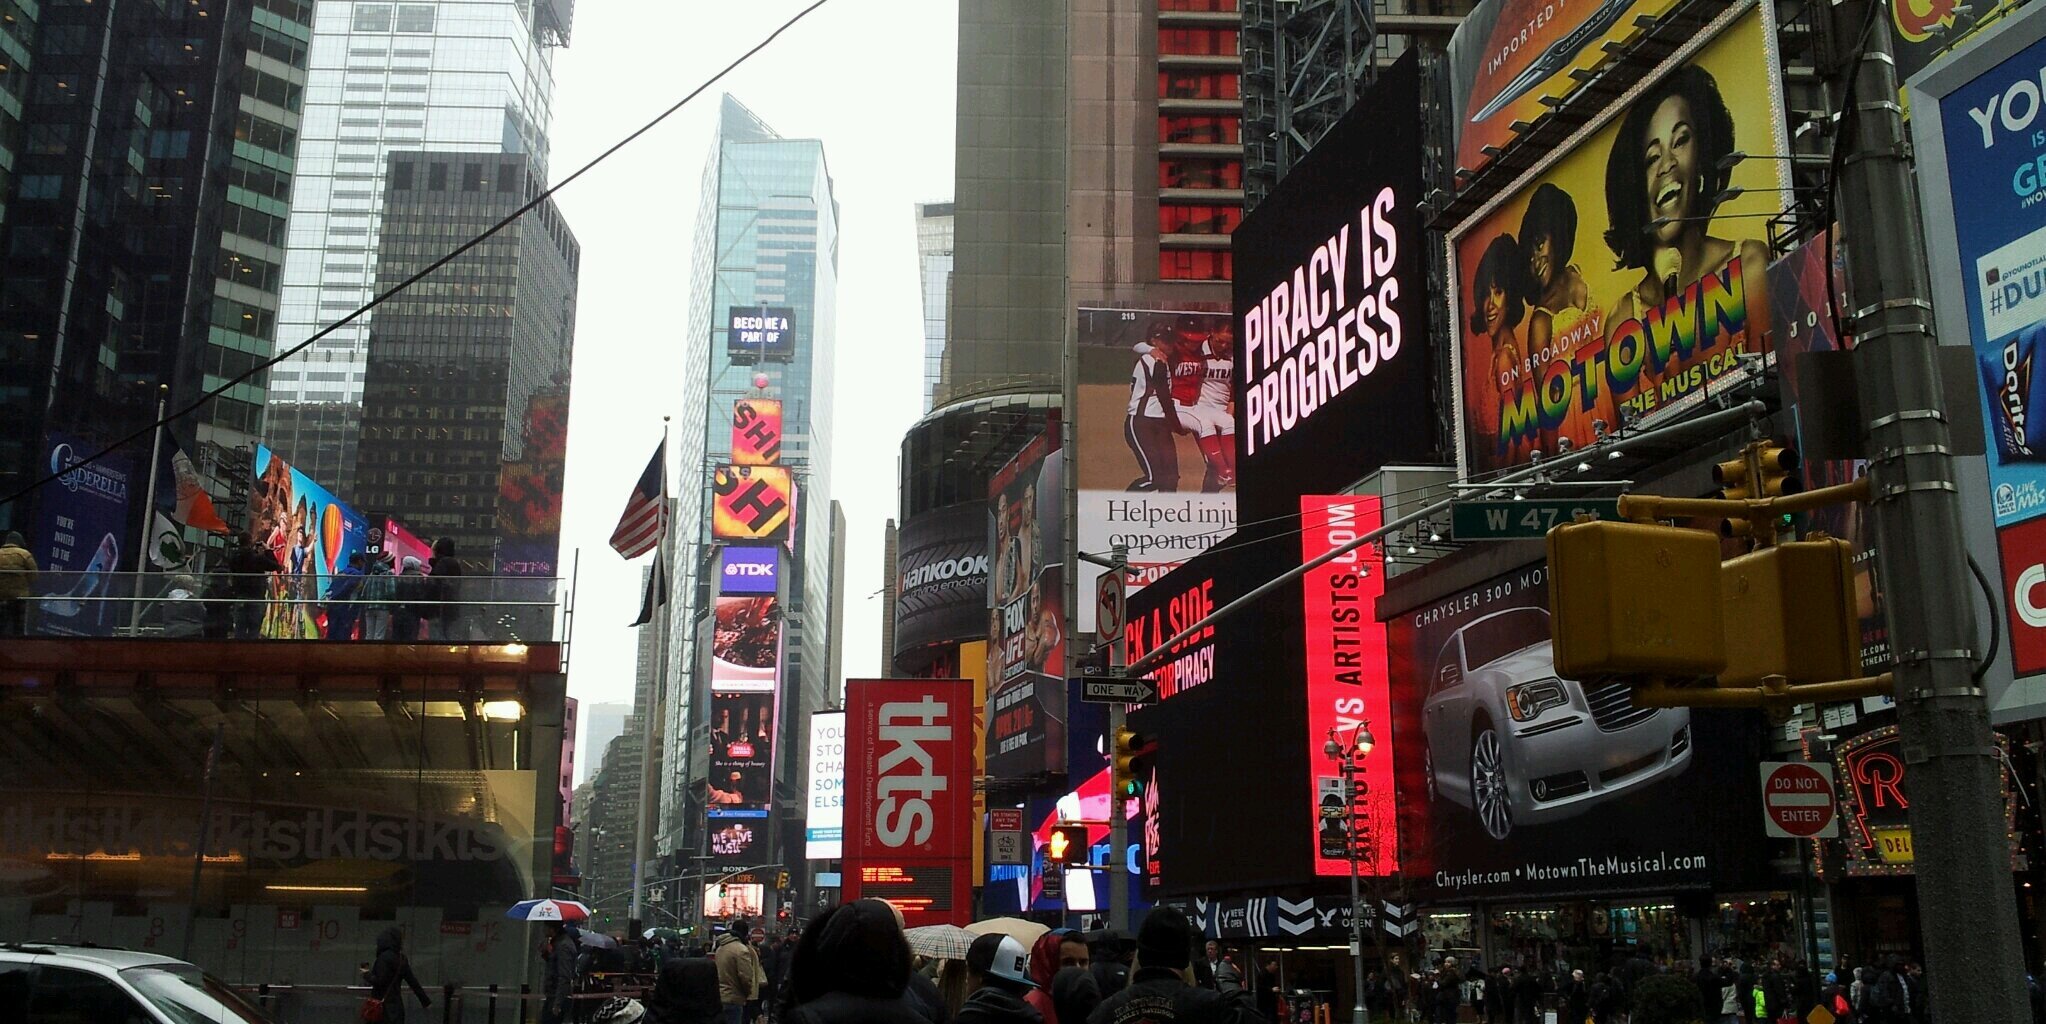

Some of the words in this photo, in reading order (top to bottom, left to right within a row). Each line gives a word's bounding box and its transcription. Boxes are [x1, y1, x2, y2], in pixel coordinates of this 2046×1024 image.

[1488, 4, 1554, 76] IMPORTED
[1559, 7, 1609, 52] CHRYSLER
[1245, 223, 1349, 384] PIRACY
[1360, 186, 1397, 289] IS
[733, 317, 778, 330] BECOME
[780, 318, 788, 330] A
[740, 331, 762, 343] PART
[766, 331, 780, 343] OF
[1501, 364, 1521, 387] ON
[1524, 315, 1601, 374] BROADWAY
[1501, 256, 1748, 448] MOTOWN
[1246, 276, 1401, 457] PROGRESS
[1621, 385, 1657, 419] THE
[2003, 342, 2033, 456] Doritos
[2015, 480, 2037, 497] LIVE
[1106, 500, 1191, 529] Helped
[1485, 508, 1509, 531] W
[1520, 508, 1559, 530] 47
[365, 545, 379, 554] LG
[1108, 529, 1222, 554] opponent
[736, 563, 774, 576] TDK
[1005, 596, 1025, 640] FOX
[1415, 593, 1480, 629] CHRYSLER
[1486, 583, 1513, 603] 300
[1152, 607, 1164, 664] A
[1169, 577, 1216, 654] SIDE
[1005, 633, 1025, 665] UFC
[1093, 685, 1113, 695] ONE
[1124, 686, 1146, 697] WAY
[817, 744, 843, 756] STO
[867, 737, 874, 745] of
[866, 747, 874, 775] Theatre
[876, 695, 952, 848] tkts
[1775, 778, 1792, 790] DO
[1796, 777, 1819, 789] NOT
[865, 777, 874, 826] Development
[1781, 810, 1821, 823] ENTER
[712, 832, 726, 844] WE
[730, 831, 752, 843] LIVE
[712, 842, 742, 854] MUSIC
[864, 827, 873, 846] Fund
[1436, 868, 1511, 889] Chrysler.com
[1526, 850, 1707, 881] MotownTheMusical.com
[151, 917, 164, 937] 8
[233, 919, 246, 938] 9
[317, 920, 340, 940] 10
